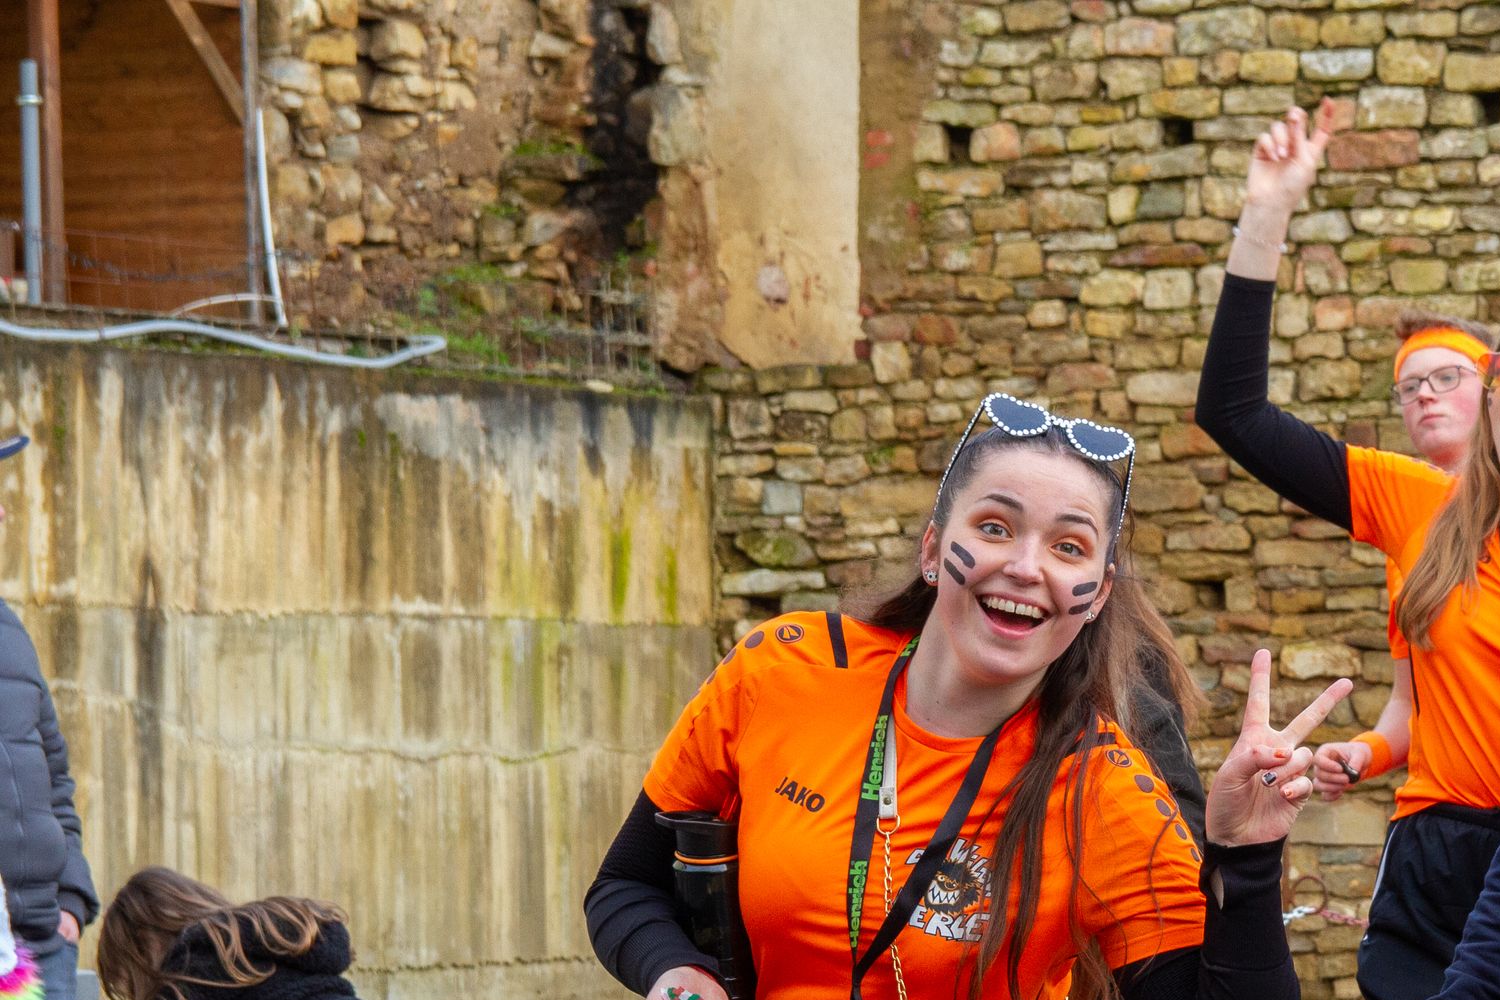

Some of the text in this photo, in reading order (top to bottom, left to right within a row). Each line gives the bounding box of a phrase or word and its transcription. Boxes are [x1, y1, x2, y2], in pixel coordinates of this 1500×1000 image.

[861, 714, 889, 801] Henrich
[774, 776, 826, 813] JAKO
[908, 903, 992, 942] ERLE
